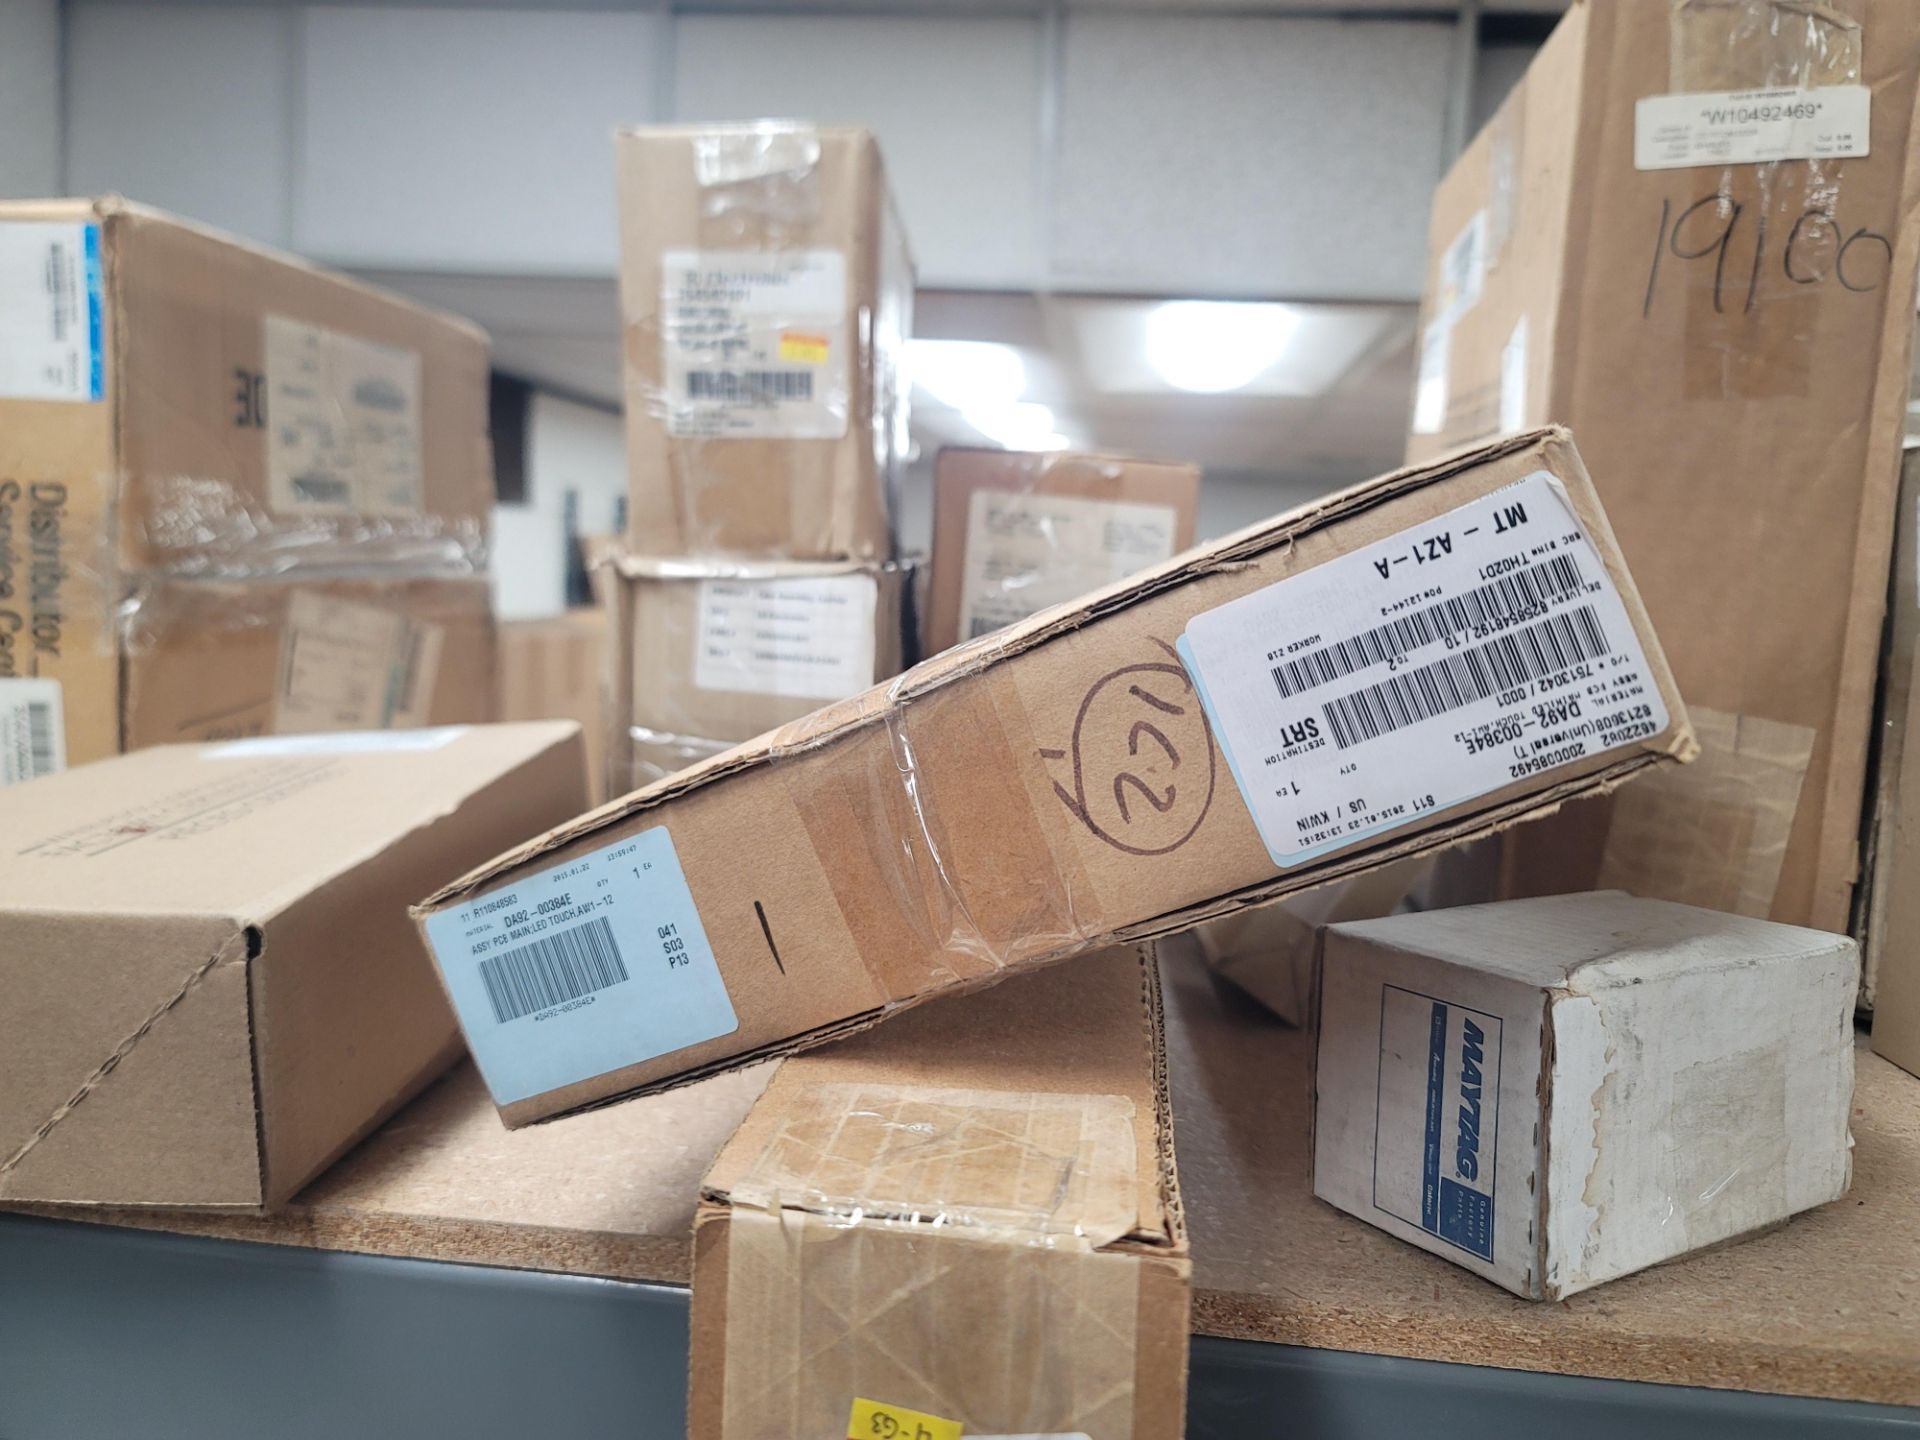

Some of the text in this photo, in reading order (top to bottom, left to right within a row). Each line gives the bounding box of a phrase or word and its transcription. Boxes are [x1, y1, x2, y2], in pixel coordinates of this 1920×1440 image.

[1493, 502, 1528, 535] MT
[1286, 634, 1322, 654] WORKER
[1442, 633, 1461, 650] 10
[1385, 657, 1397, 672] 2
[1280, 717, 1320, 749] SRT
[1264, 737, 1326, 766] DESTINATION
[1275, 787, 1288, 798] EA
[1290, 781, 1301, 796] 1
[1348, 798, 1367, 814] US
[1296, 811, 1330, 832] KWIN
[1347, 804, 1405, 831] 2015.01.23
[1298, 825, 1343, 847] 13:32:51
[632, 866, 640, 879] 1
[642, 862, 653, 871] EA
[657, 922, 678, 939] 041
[471, 941, 491, 956] ASSY
[492, 933, 509, 947] PCB
[662, 937, 684, 955] S03
[668, 952, 690, 970] P13
[1456, 1016, 1485, 1183] MAYTAG
